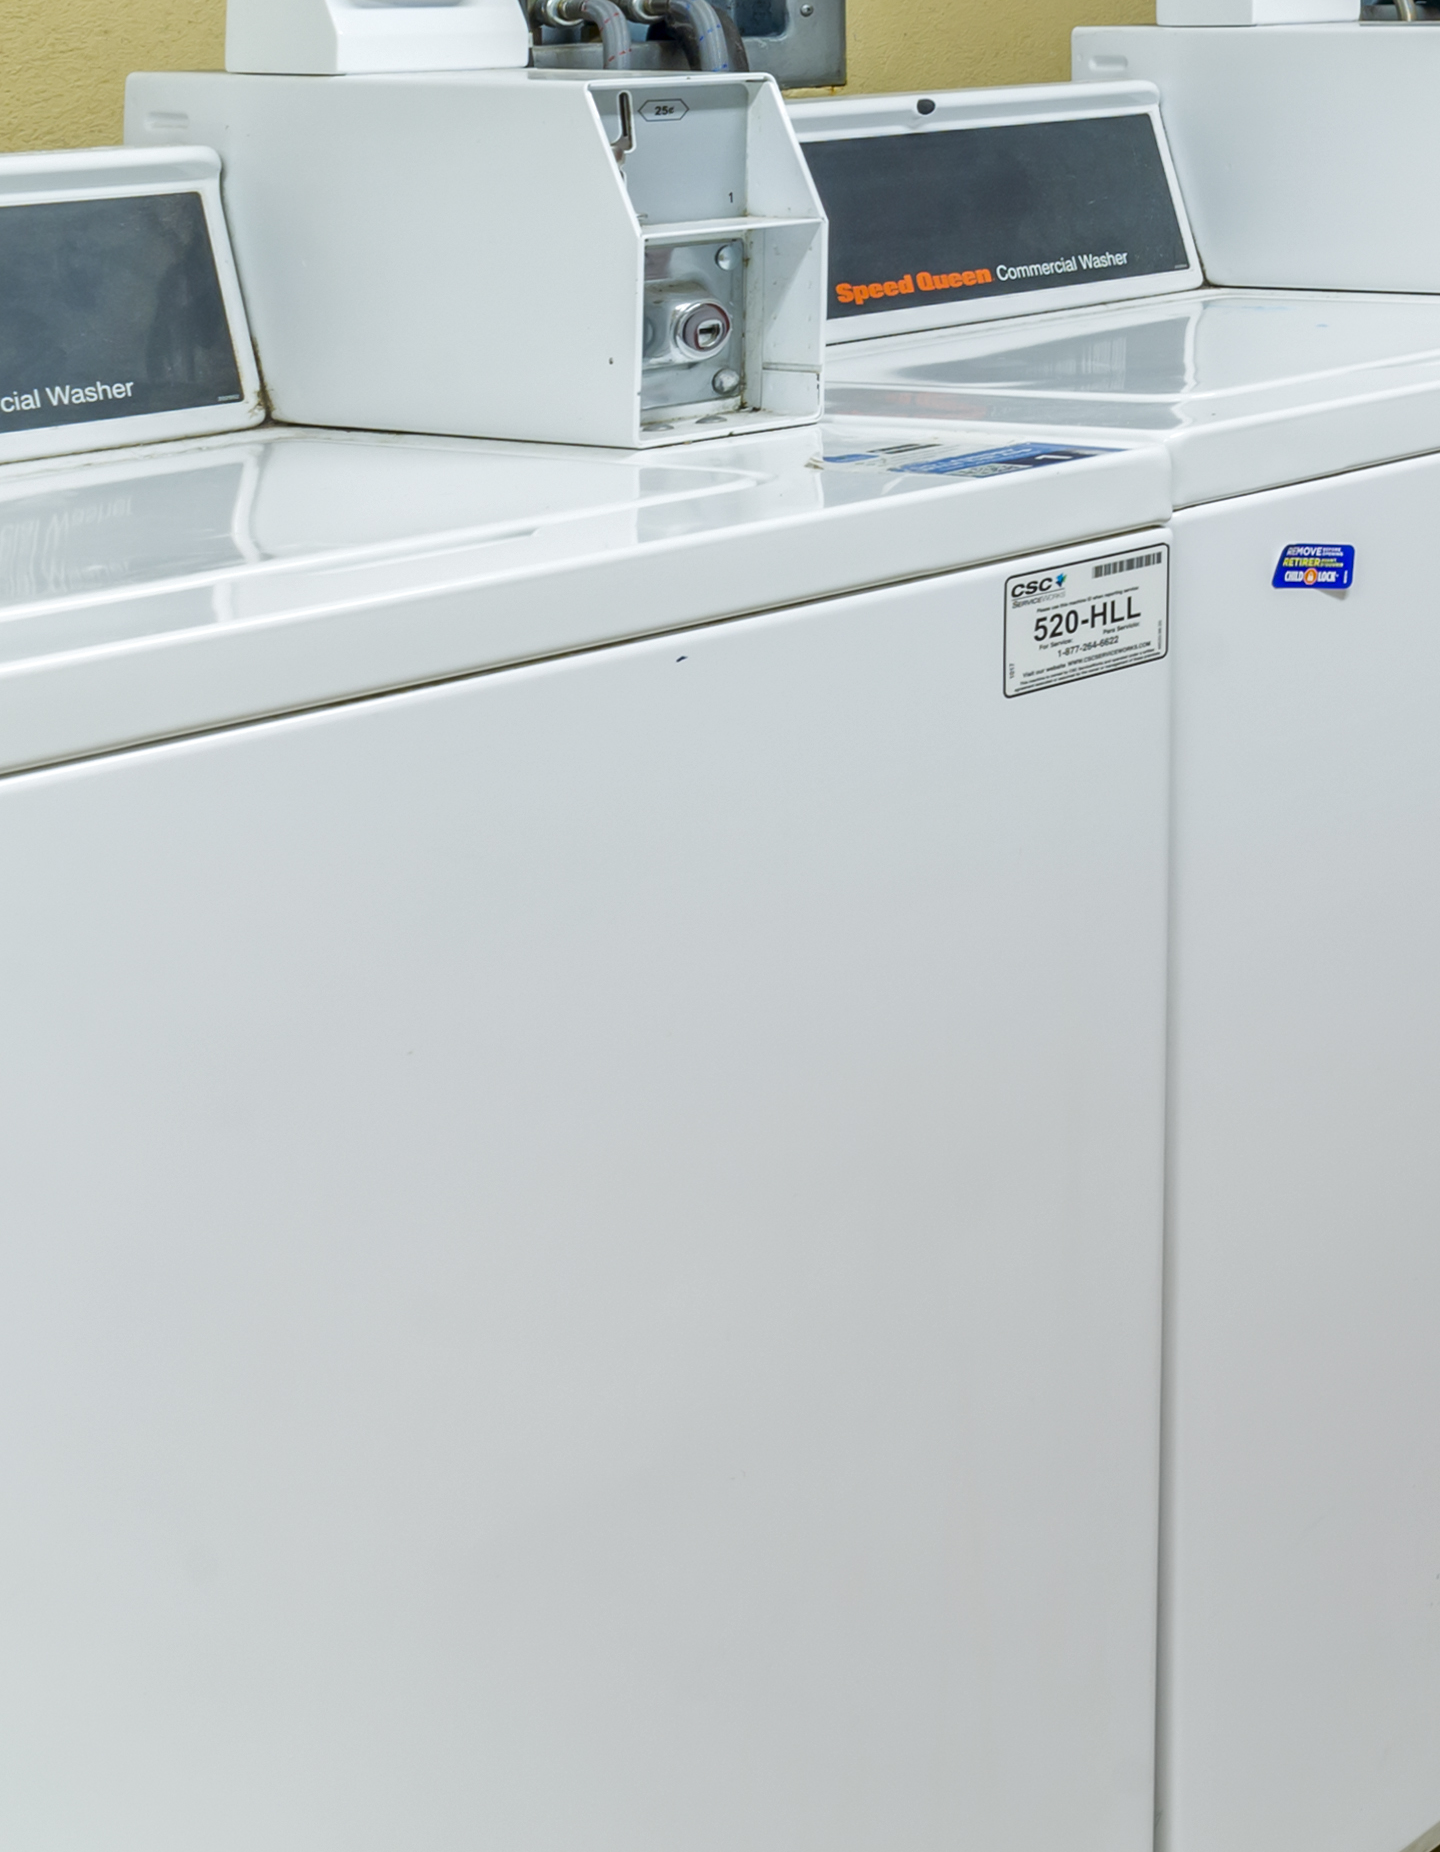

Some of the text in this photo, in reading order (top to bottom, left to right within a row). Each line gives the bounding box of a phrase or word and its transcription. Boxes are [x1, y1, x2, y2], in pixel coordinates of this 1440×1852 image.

[654, 105, 675, 116] 25¢
[728, 191, 733, 203] 1
[835, 251, 1128, 305] Speed Queen Commercial Washer
[45, 381, 134, 407] Washer
[1286, 546, 1323, 556] REMOVE
[1282, 557, 1321, 567] RETIRER
[1284, 570, 1304, 582] CHILD
[1011, 577, 1053, 598] CSC
[1034, 595, 1141, 642] 520-HLL
